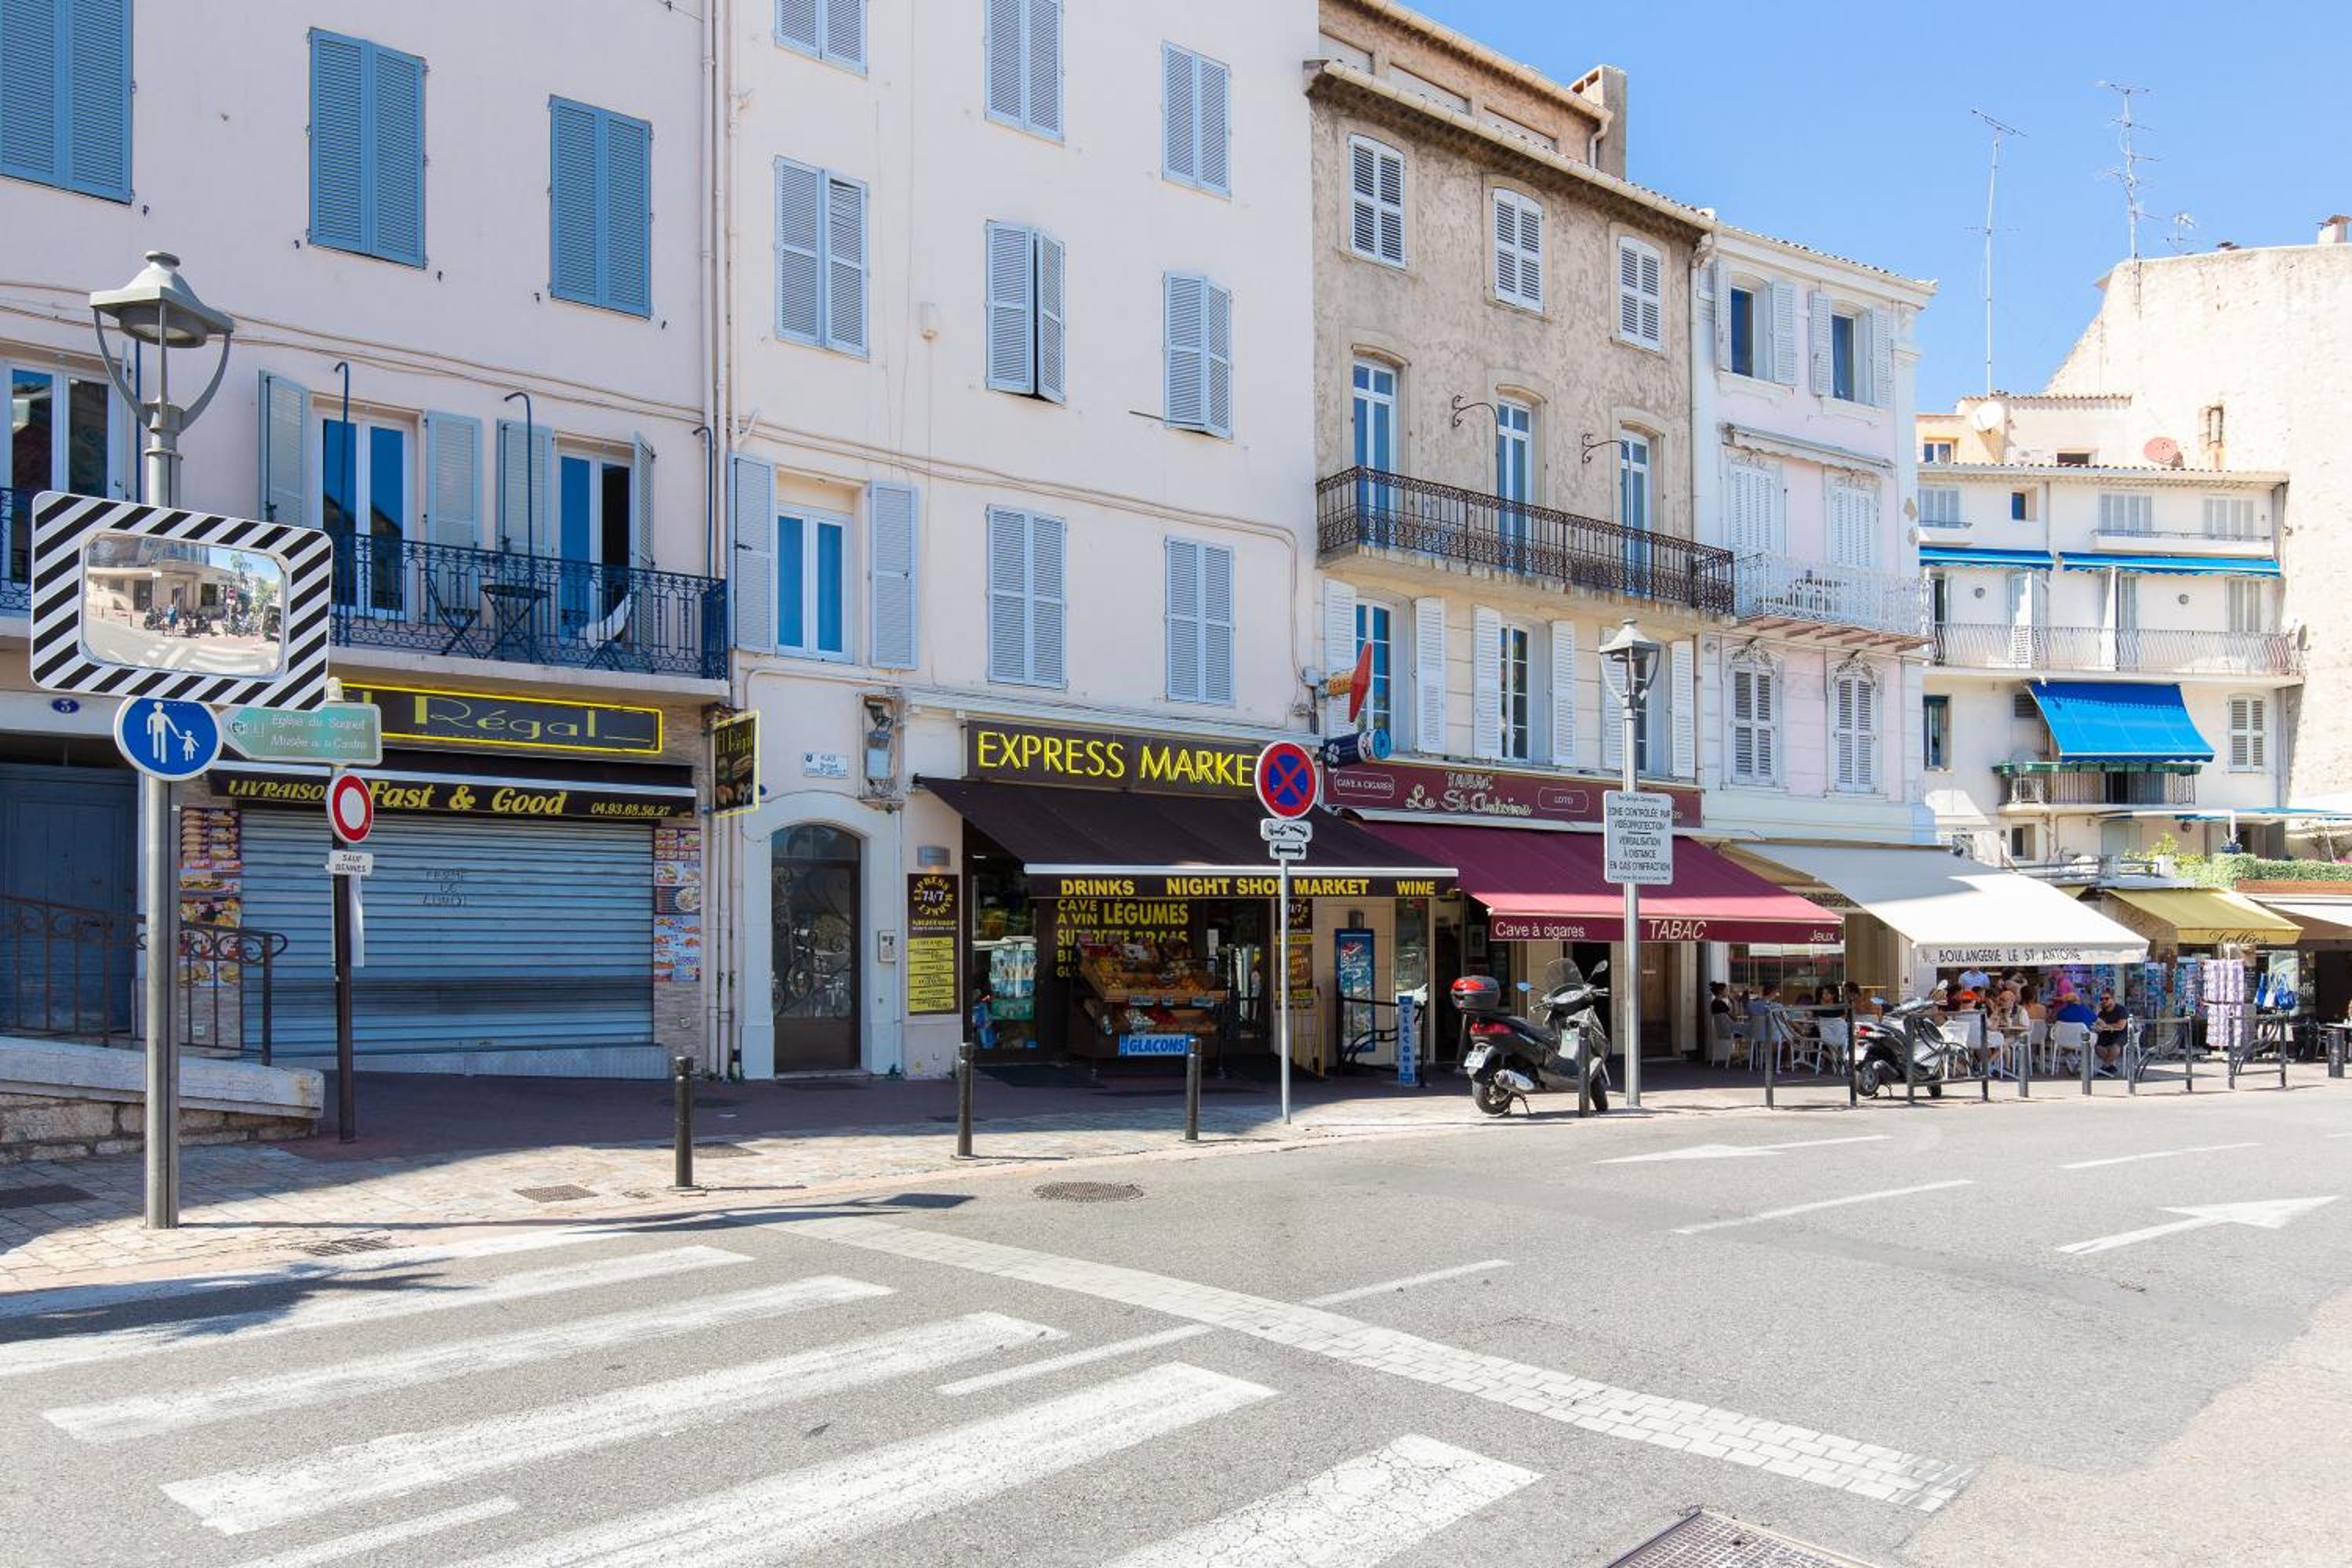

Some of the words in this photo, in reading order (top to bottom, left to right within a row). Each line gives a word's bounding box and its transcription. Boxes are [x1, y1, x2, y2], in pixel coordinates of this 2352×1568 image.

[414, 695, 597, 740] Régal
[977, 730, 1126, 779] EXPRESS
[1139, 743, 1257, 787] MARKE
[228, 780, 328, 800] LIVRAISO
[370, 780, 434, 808] Fast
[449, 784, 477, 811] &
[492, 786, 568, 815] Good
[1404, 783, 1437, 810] Le
[1061, 879, 1135, 896] DRINKS
[1166, 877, 1230, 895] NIGHT
[1236, 878, 1282, 895] SHO
[1294, 878, 1370, 895] MARKET
[1396, 880, 1436, 895] WINE
[1058, 899, 1098, 912] CAVE
[1072, 913, 1098, 925] VIN
[1495, 921, 1529, 937] Cave
[1532, 922, 1541, 937] à
[1544, 923, 1585, 940] cigares
[1649, 920, 1707, 940] TABAC
[1809, 930, 1835, 942] Jeux
[1939, 949, 2002, 963] BOULANGERIE
[2008, 949, 2019, 962] LE
